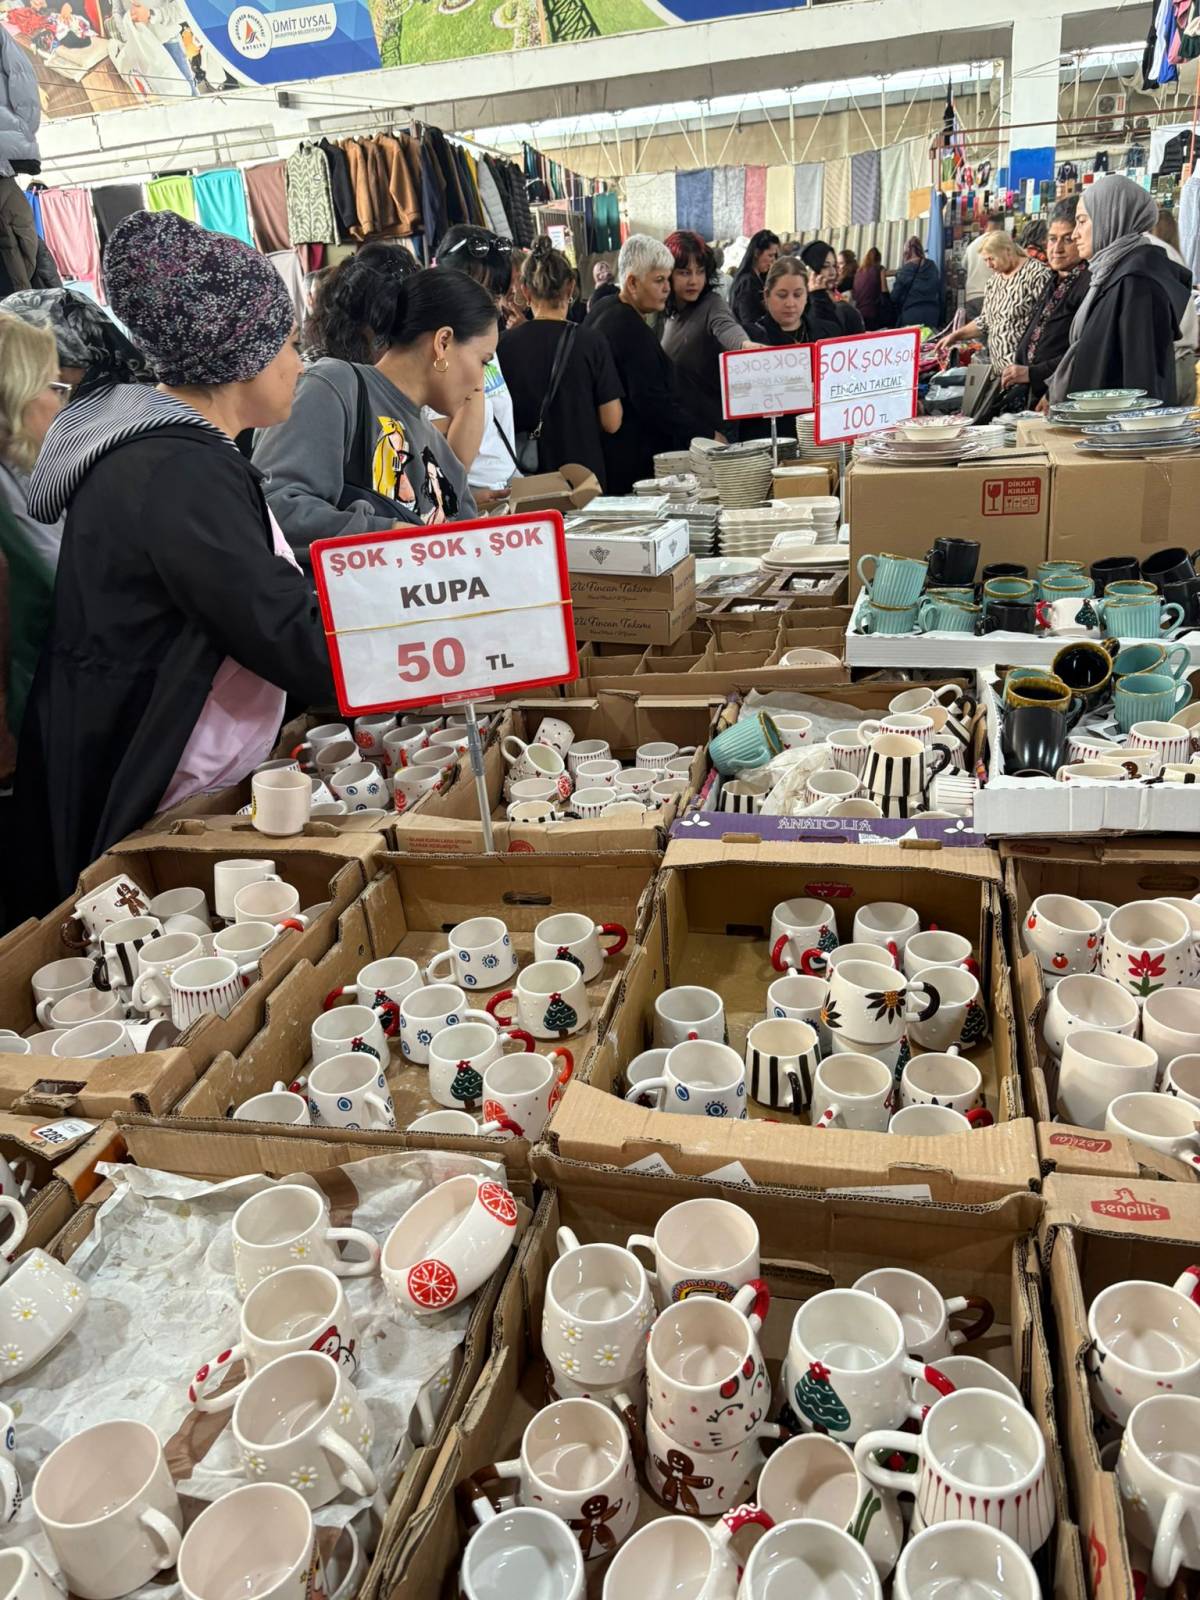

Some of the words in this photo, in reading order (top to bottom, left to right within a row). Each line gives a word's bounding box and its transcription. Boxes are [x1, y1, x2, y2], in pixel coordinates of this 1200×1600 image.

[272, 17, 297, 33] ÜMİT
[299, 14, 331, 29] UYSAL
[843, 403, 875, 431] 100
[879, 413, 890, 424] TL
[330, 547, 387, 577] ŞOK
[411, 537, 467, 566] ŞOK
[489, 527, 543, 556] ŞOK
[400, 576, 490, 609] KUPA
[397, 637, 467, 683] 50
[485, 653, 515, 671] TL
[777, 816, 873, 832] ANATOLIA
[1099, 1203, 1161, 1220] şenpiliç
